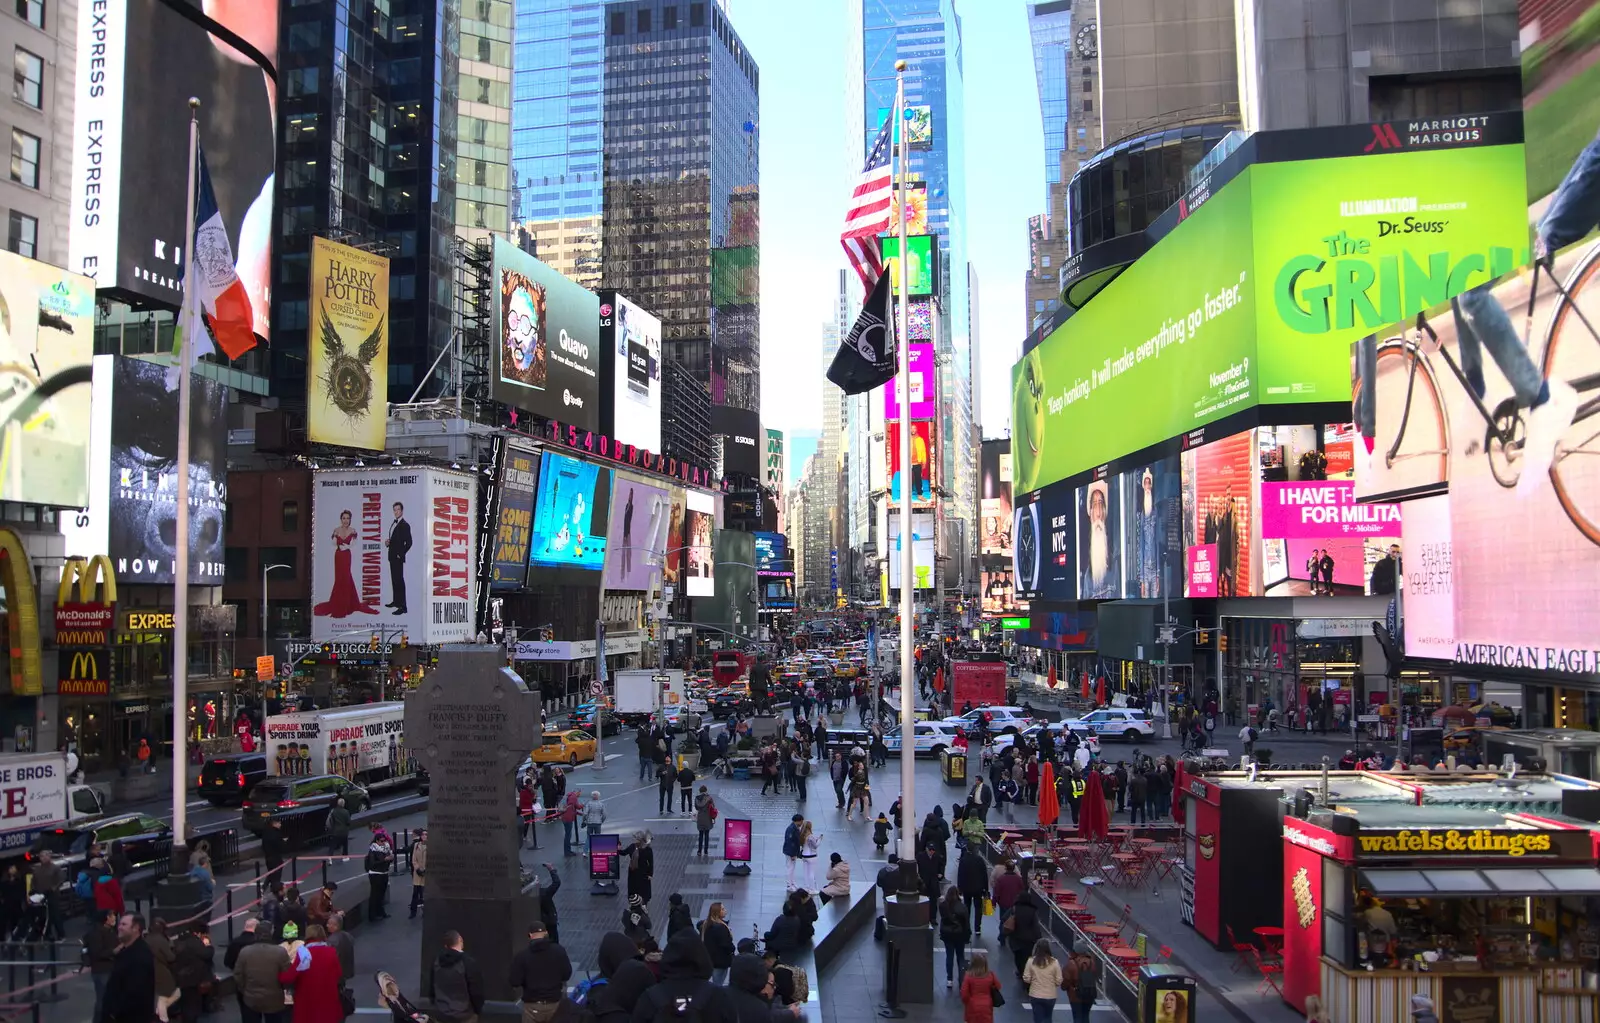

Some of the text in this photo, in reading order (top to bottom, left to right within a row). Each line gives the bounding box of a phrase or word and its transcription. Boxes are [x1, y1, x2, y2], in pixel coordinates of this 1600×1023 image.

[1408, 116, 1489, 133] MARRIOTT
[1409, 130, 1480, 145] MARQUIS
[85, 119, 103, 227] EXPRESS
[1340, 196, 1418, 217] ILLUMINATION
[1377, 220, 1401, 238] Dr.
[1321, 229, 1371, 258] The
[328, 258, 377, 291] HARRY
[324, 276, 380, 310] POTTER
[330, 302, 374, 320] CURSED CHILD
[600, 318, 611, 327] LG
[559, 328, 589, 360] Quavo
[1098, 357, 1111, 386] will
[1112, 346, 1135, 378] make
[1135, 317, 1185, 363] everything
[1188, 307, 1202, 339] go
[1209, 362, 1243, 389] November
[1243, 357, 1249, 373] 9
[551, 419, 710, 487] 1540 BROADWAY
[120, 489, 175, 504] BREAKING
[187, 497, 204, 507] REE
[1279, 487, 1285, 505] I
[1288, 487, 1336, 505] HAVE
[362, 492, 382, 546] PRETTY
[501, 507, 531, 528] COME
[1051, 514, 1066, 529] WE ARE
[1301, 503, 1402, 524] FOR MILITA
[498, 525, 529, 546] FROM
[1052, 530, 1067, 553] NYC
[433, 496, 452, 597] WOMAN
[450, 496, 469, 600] PRETTY
[496, 543, 527, 563] AWAY
[119, 558, 159, 574] NOW
[362, 551, 382, 606] WOMAN
[56, 610, 111, 620] McDonald's
[432, 601, 469, 624] THE MUSICAL
[286, 643, 322, 654] GIFTS
[513, 641, 560, 657] Disney store
[1455, 643, 1539, 670] AMERICAN
[125, 704, 150, 714] EXPRESS
[428, 712, 466, 721] FRANCIS
[476, 712, 508, 722] DUFFY
[268, 722, 319, 731] UPGRADE YOUR
[270, 731, 318, 740] SPORTS DRINK
[329, 725, 364, 742] UPGRADE
[364, 723, 384, 737] YOUR
[16, 765, 57, 781] BROS.
[29, 812, 53, 823] BLOCKS
